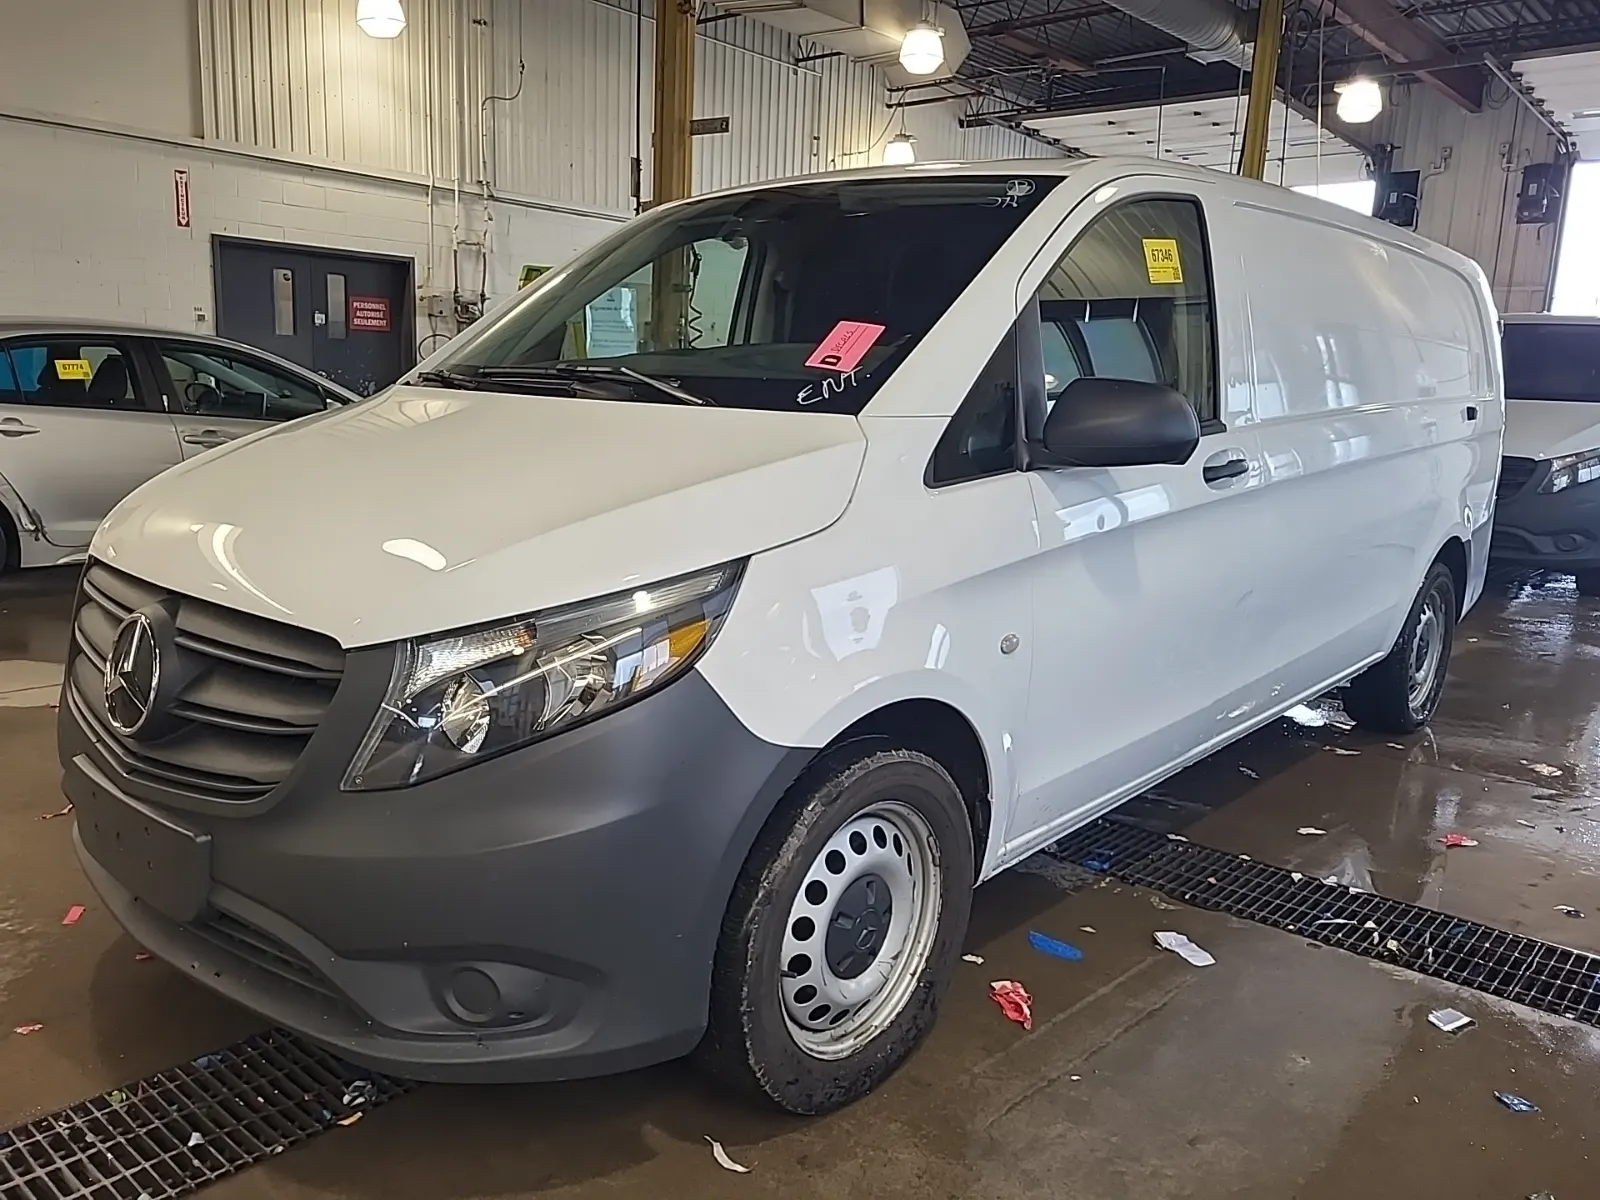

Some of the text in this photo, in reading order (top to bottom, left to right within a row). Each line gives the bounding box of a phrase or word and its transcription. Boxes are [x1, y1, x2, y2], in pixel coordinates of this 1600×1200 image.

[1151, 248, 1173, 263] 67346
[353, 301, 387, 311] PERSONNEL
[353, 317, 387, 327] SEULEMENT
[818, 354, 842, 367] D
[62, 363, 84, 371] 67774
